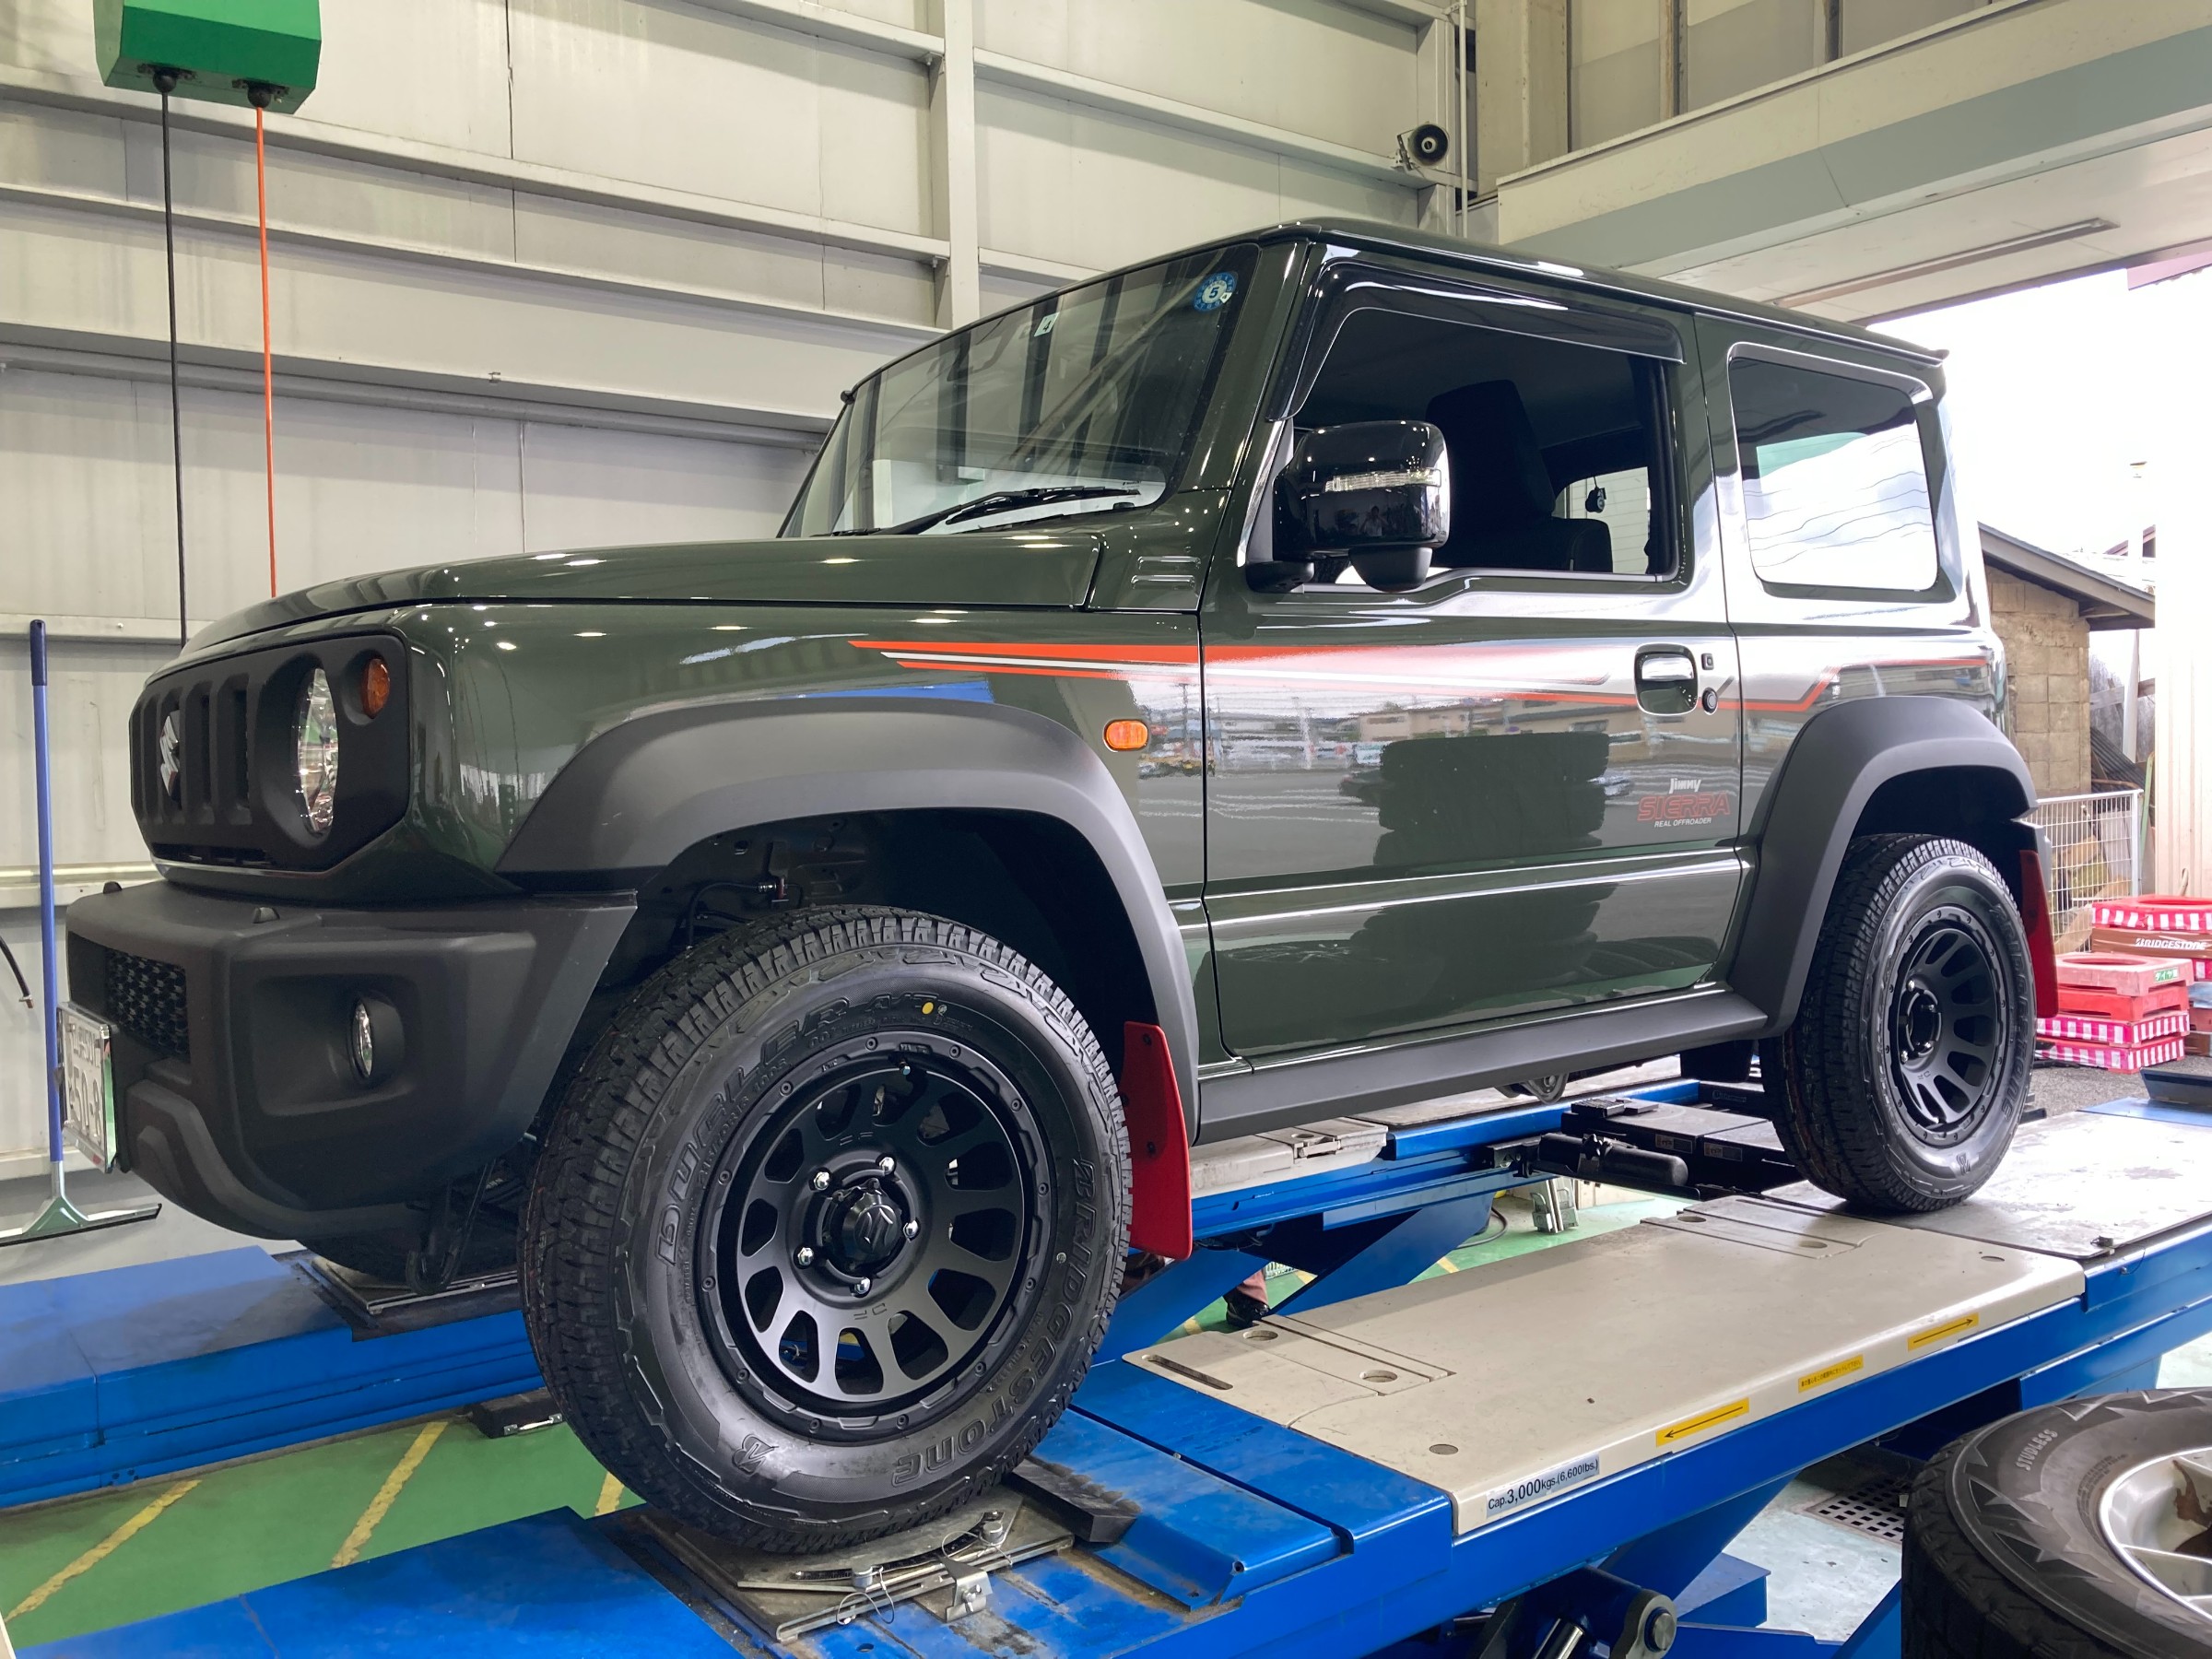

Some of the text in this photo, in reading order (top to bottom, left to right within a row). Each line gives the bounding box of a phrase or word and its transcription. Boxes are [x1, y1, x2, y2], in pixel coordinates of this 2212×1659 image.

[1208, 286, 1219, 298] 5
[1669, 778, 1701, 794] Jimny
[1637, 791, 1730, 821] SIERRA
[1673, 818, 1712, 826] OFFROADER
[2135, 937, 2206, 950] BRIDGESTONE
[2155, 969, 2178, 982] タイヤ
[655, 997, 849, 1266] DUELER
[890, 1158, 1097, 1487] BRIDGESTONE
[2016, 1429, 2058, 1471] STUDLESS
